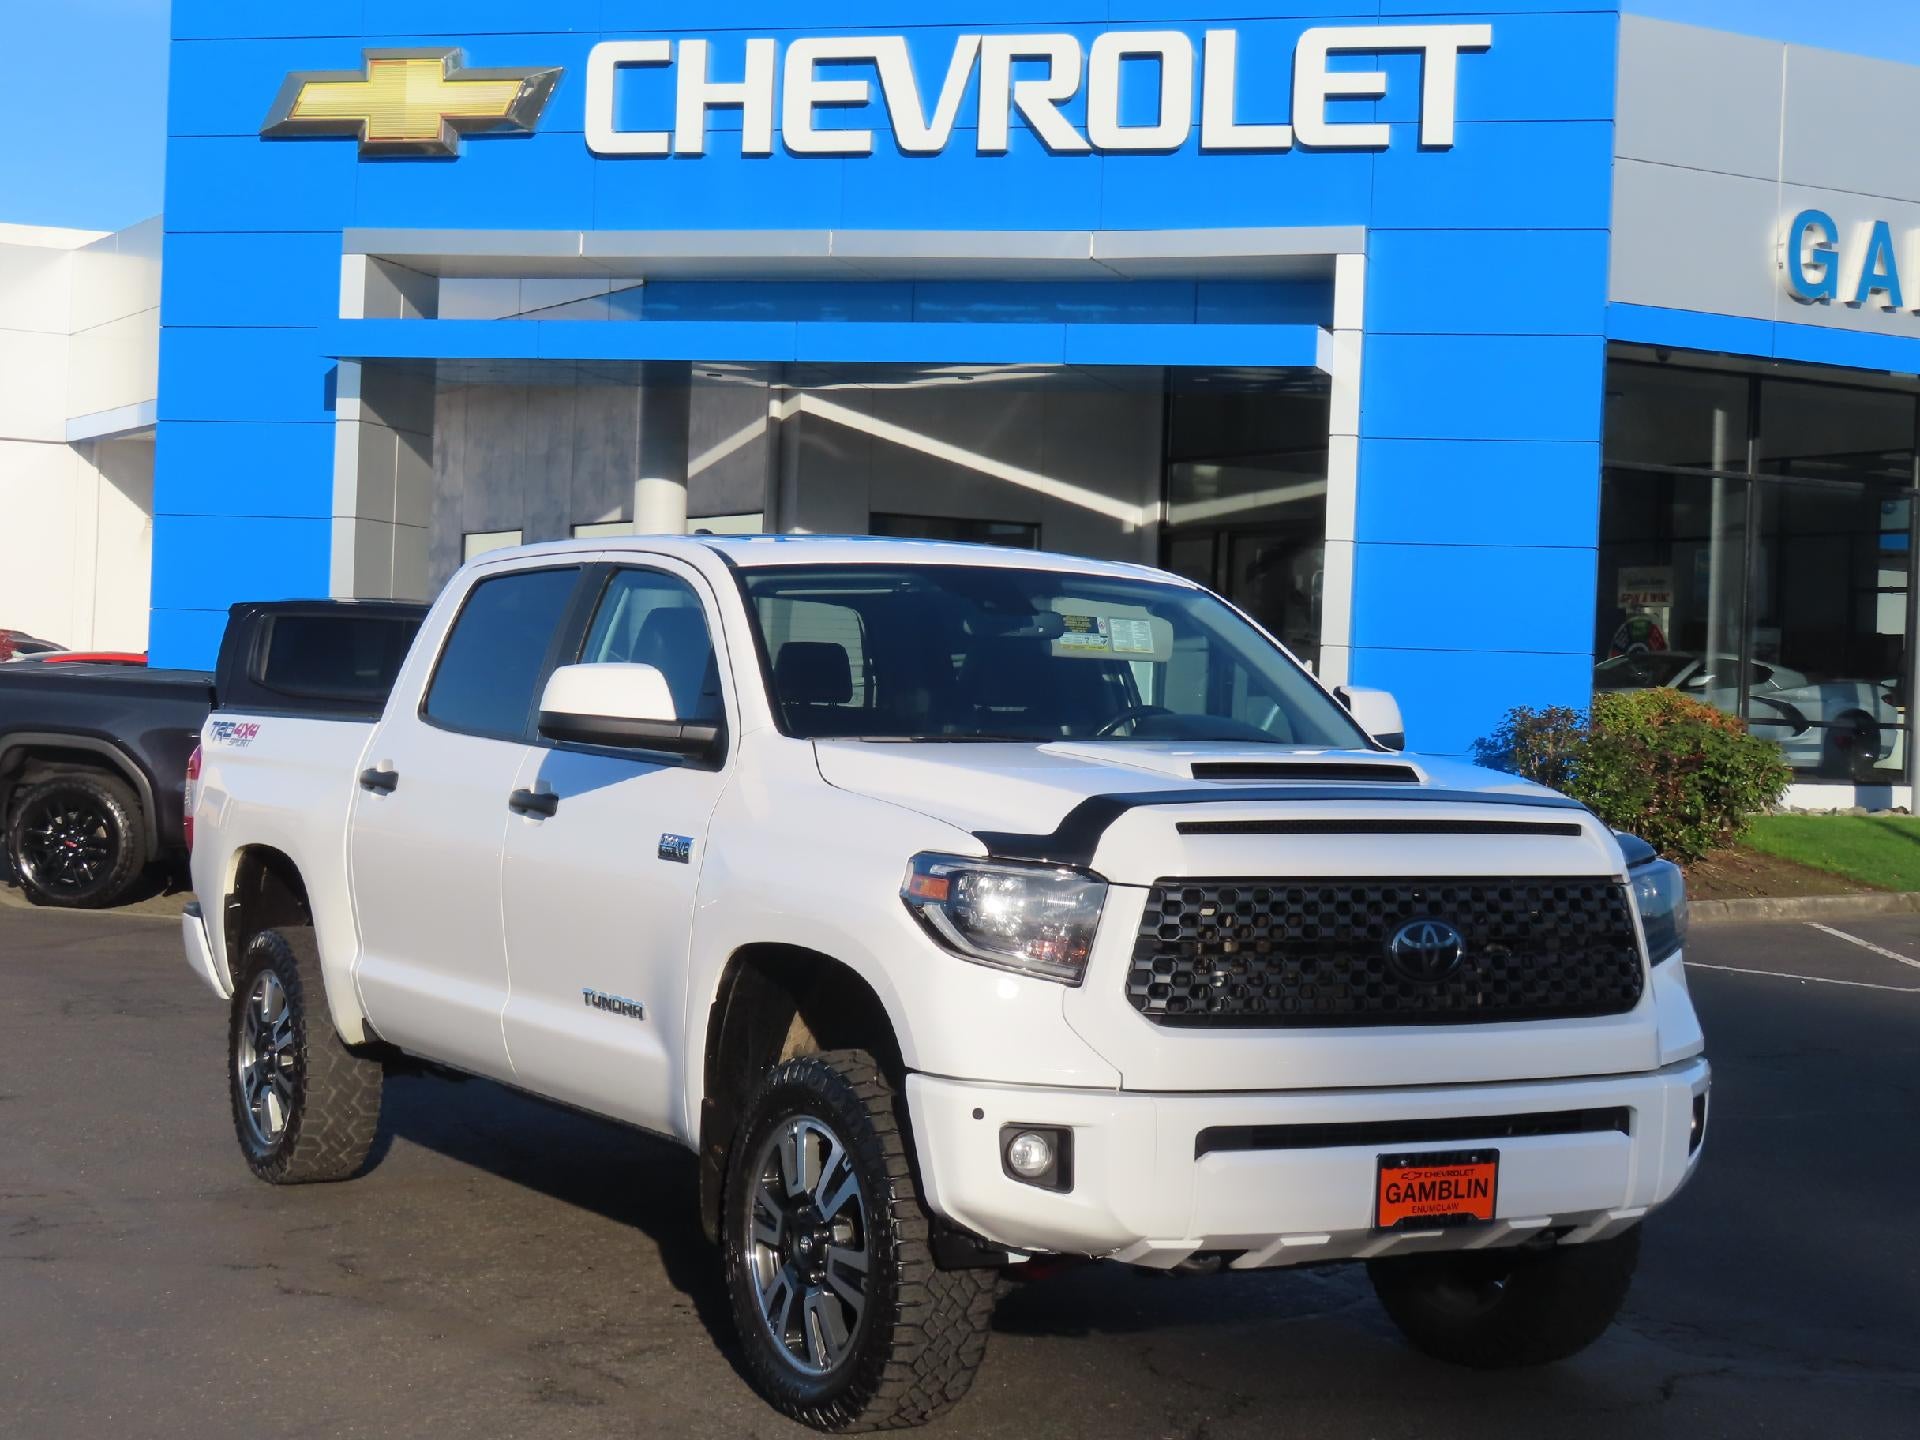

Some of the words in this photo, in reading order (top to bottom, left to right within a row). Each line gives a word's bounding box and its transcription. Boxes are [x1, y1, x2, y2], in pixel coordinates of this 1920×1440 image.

[584, 23, 1492, 156] CHEVROLET
[1788, 208, 1920, 311] GA
[582, 987, 645, 1021] TUNDRA
[1423, 1168, 1476, 1179] CHEVROLET
[1385, 1178, 1489, 1204] GAMBLIN
[1411, 1202, 1461, 1214] ENUMCLAW
